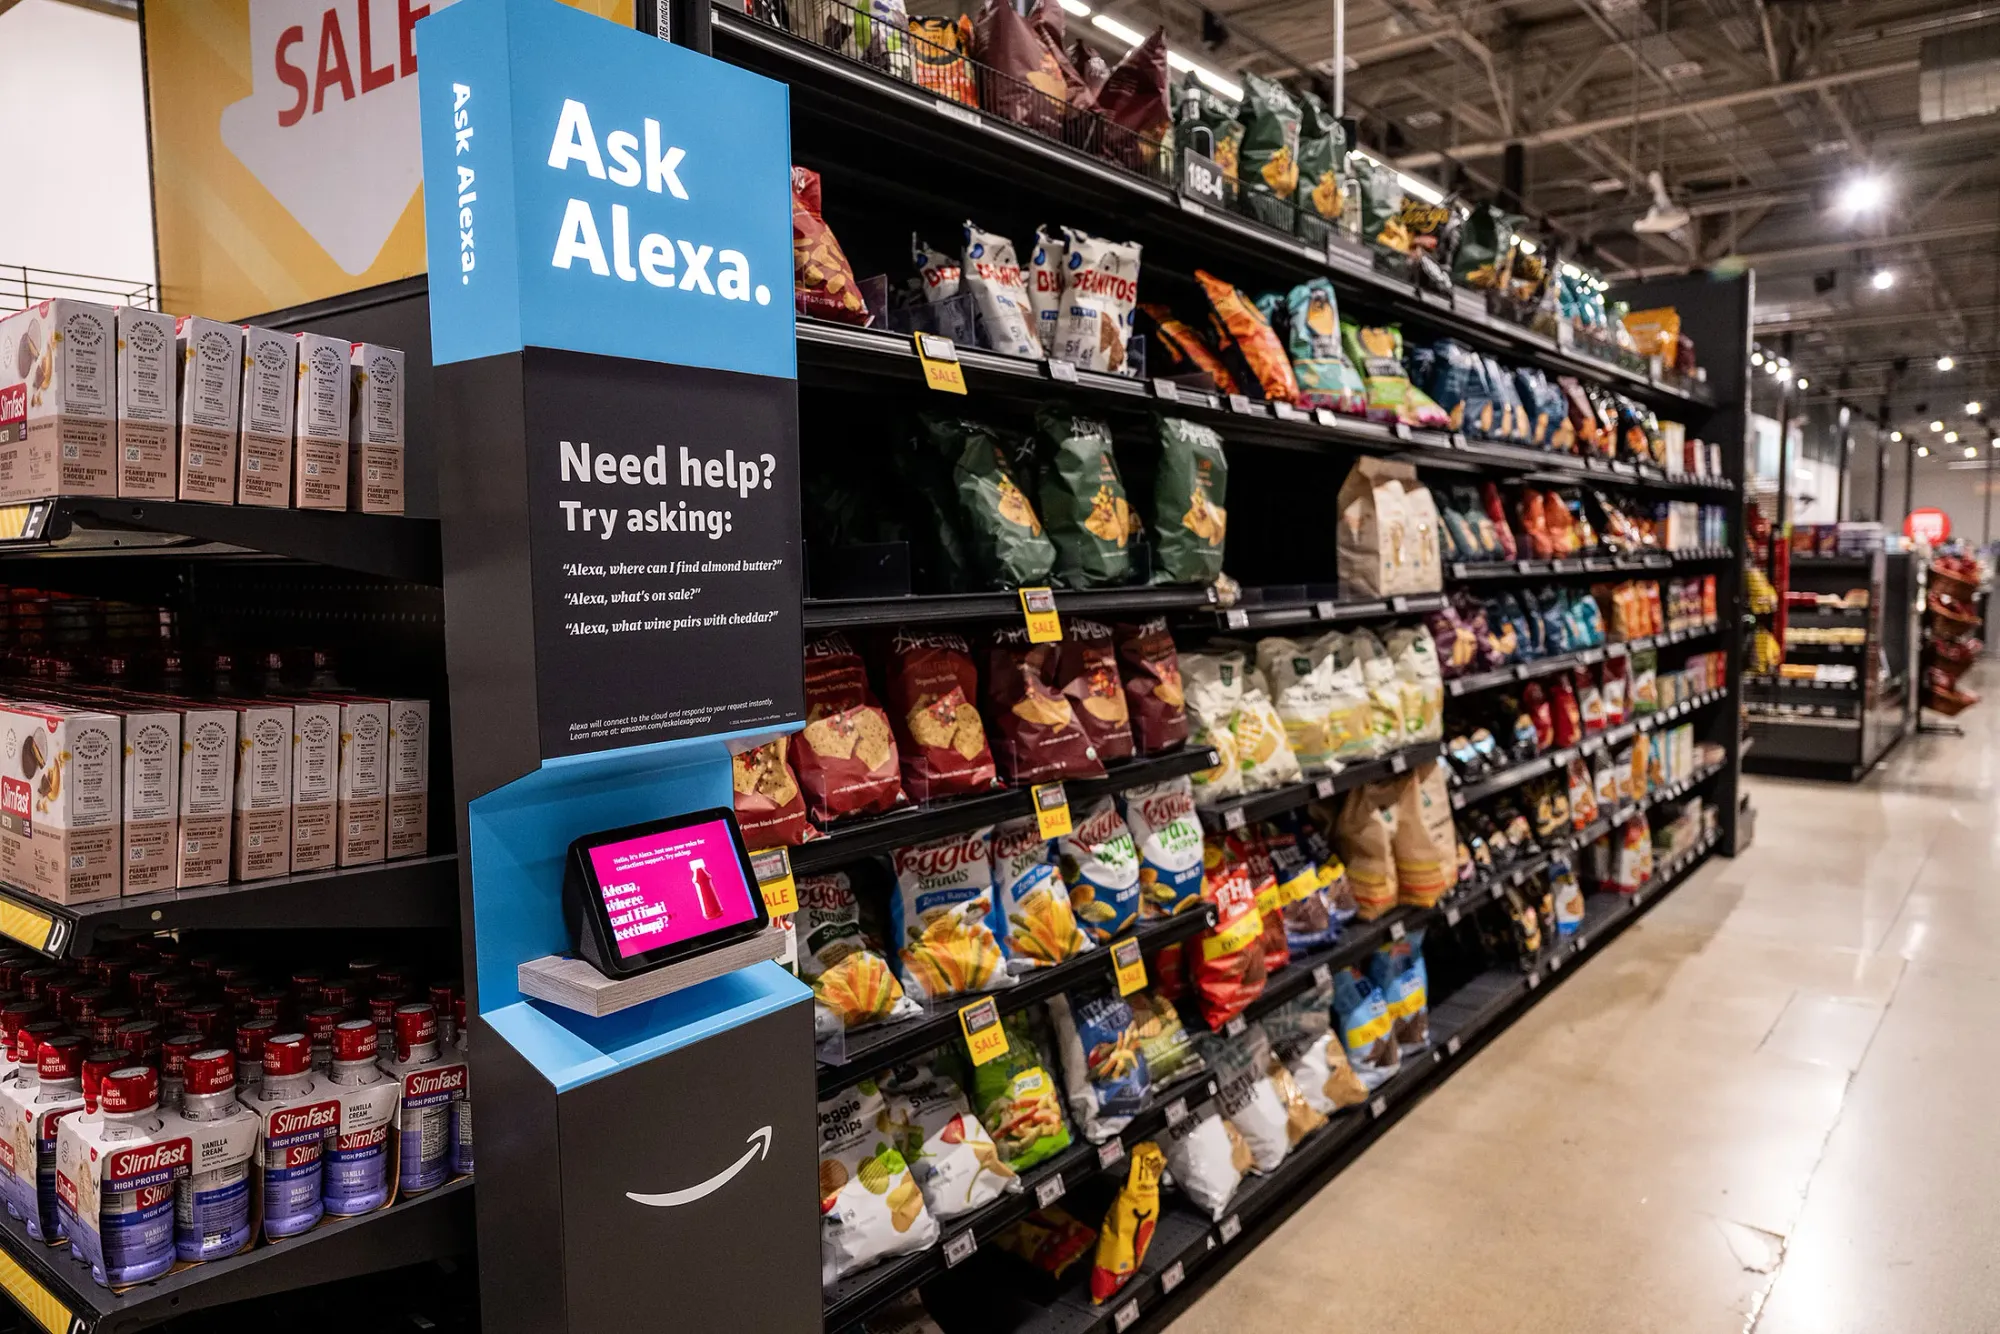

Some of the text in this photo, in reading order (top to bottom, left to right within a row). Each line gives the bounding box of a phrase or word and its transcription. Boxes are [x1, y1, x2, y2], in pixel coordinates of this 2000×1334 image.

[275, 0, 430, 127] SALE
[547, 98, 689, 200] Ask
[453, 82, 476, 286] Ask Alexa.
[551, 198, 771, 306] Alexa.
[930, 367, 960, 384] SALE
[63, 466, 107, 476] PEANUT BUTTER
[125, 469, 146, 477] PEANUT
[559, 440, 776, 498] Need help?
[25, 506, 43, 538] E
[559, 500, 732, 540] Try asking:
[609, 562, 645, 575] where
[646, 564, 667, 574] can
[669, 561, 675, 573] I
[675, 561, 700, 576] find
[701, 560, 741, 572] almond
[610, 590, 650, 603] what's
[651, 592, 666, 601] on
[611, 619, 642, 633] what
[644, 617, 672, 630] wine
[673, 615, 702, 631] pairs
[703, 614, 727, 627] with
[1032, 620, 1056, 634] SALE
[569, 723, 589, 731] Alexa
[589, 719, 602, 728] will
[603, 716, 629, 727] connect
[630, 715, 637, 723] to
[638, 714, 649, 722] the
[650, 711, 668, 720] cloud
[668, 709, 681, 717] and
[681, 707, 705, 717] respond
[713, 704, 726, 714] your
[727, 701, 748, 712] request
[570, 732, 590, 741] Learn
[590, 729, 609, 738] more
[620, 715, 712, 734] amazon.com/askalexagrocery
[1043, 813, 1067, 830] SALE
[896, 839, 984, 877] Veggie
[129, 866, 149, 874] PEANUT
[763, 888, 789, 906] ALE
[48, 919, 65, 951] D
[974, 1032, 1001, 1054] SALE
[41, 1064, 66, 1073] PROTEIN
[216, 1066, 230, 1076] HIGH
[210, 1074, 233, 1086] PROTEIN
[410, 1070, 463, 1095] SlimFast
[103, 1097, 127, 1106] PROTEIN
[107, 1089, 121, 1097] HIGH
[407, 1094, 449, 1107] HIGH PROTEIN
[348, 1102, 372, 1112] VANILLA
[348, 1110, 368, 1120] CREAM
[275, 1106, 336, 1134] SlimFast
[823, 1119, 862, 1141] Chips
[201, 1138, 228, 1150] VANILLA
[272, 1131, 320, 1148] HIGH PROTEIN
[116, 1144, 188, 1176] SlimFast
[201, 1147, 223, 1158] CREAM
[291, 1145, 323, 1165] Slim
[341, 1152, 355, 1160] HIGH
[114, 1172, 168, 1190] HIGH PROTEIN
[290, 1168, 305, 1178] HIGH
[290, 1184, 314, 1196] VANILLA
[142, 1210, 158, 1219] HIGH
